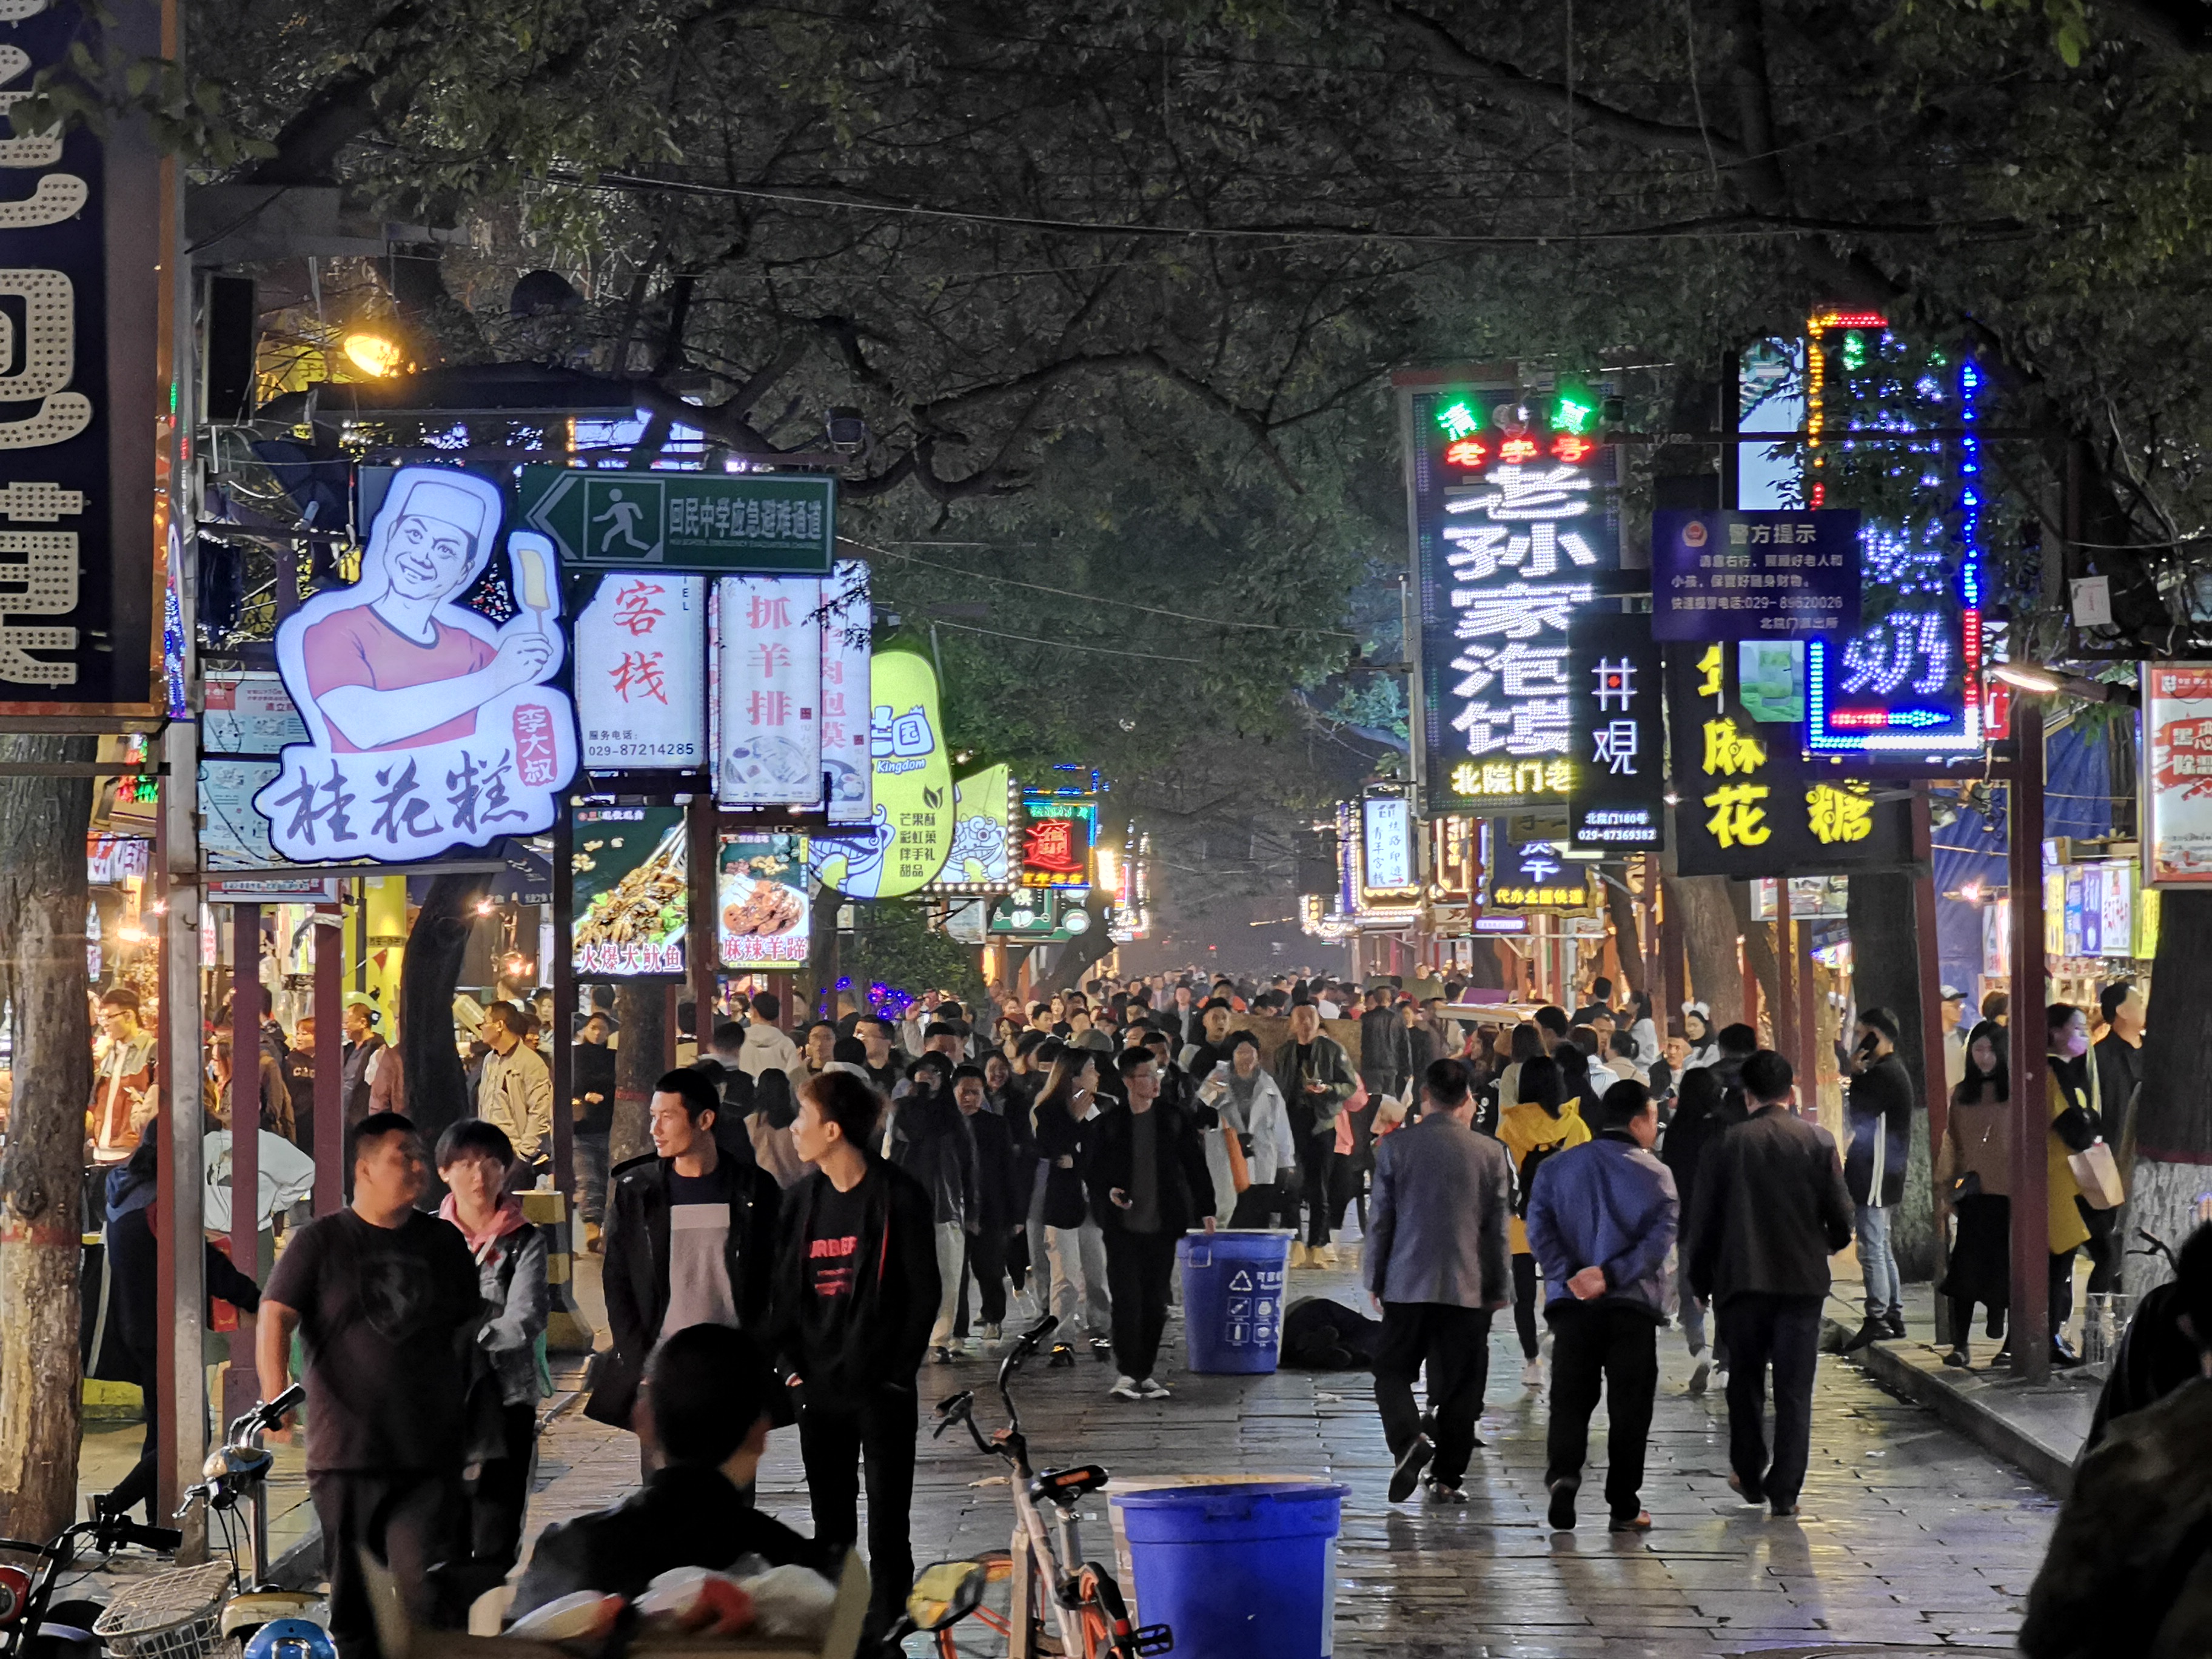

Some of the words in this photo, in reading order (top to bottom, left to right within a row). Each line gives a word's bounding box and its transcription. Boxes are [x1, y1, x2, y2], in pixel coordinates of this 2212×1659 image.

[1447, 438, 1590, 465] 老字号
[669, 497, 822, 540] 回民中学应急避难通道
[1729, 523, 1817, 544] 警方提示
[608, 578, 668, 706] 客栈
[746, 595, 792, 726] 抓羊排
[517, 708, 557, 783] 李大叔
[588, 730, 638, 741] 服务电话：
[588, 743, 695, 757] 029-87214285
[876, 759, 926, 774] Kingdom
[273, 747, 529, 846] 桂花糕
[900, 813, 936, 826] 芒果酥
[1585, 813, 1649, 825] 北院门180号
[1578, 829, 1657, 841] 029-87369382
[900, 848, 936, 862] 伴手礼
[1373, 826, 1386, 885] 青年客栈
[900, 864, 923, 877] 甜品
[578, 943, 683, 973] 火爆大鱿鱼
[723, 936, 808, 960] 麻辣羊蹄
